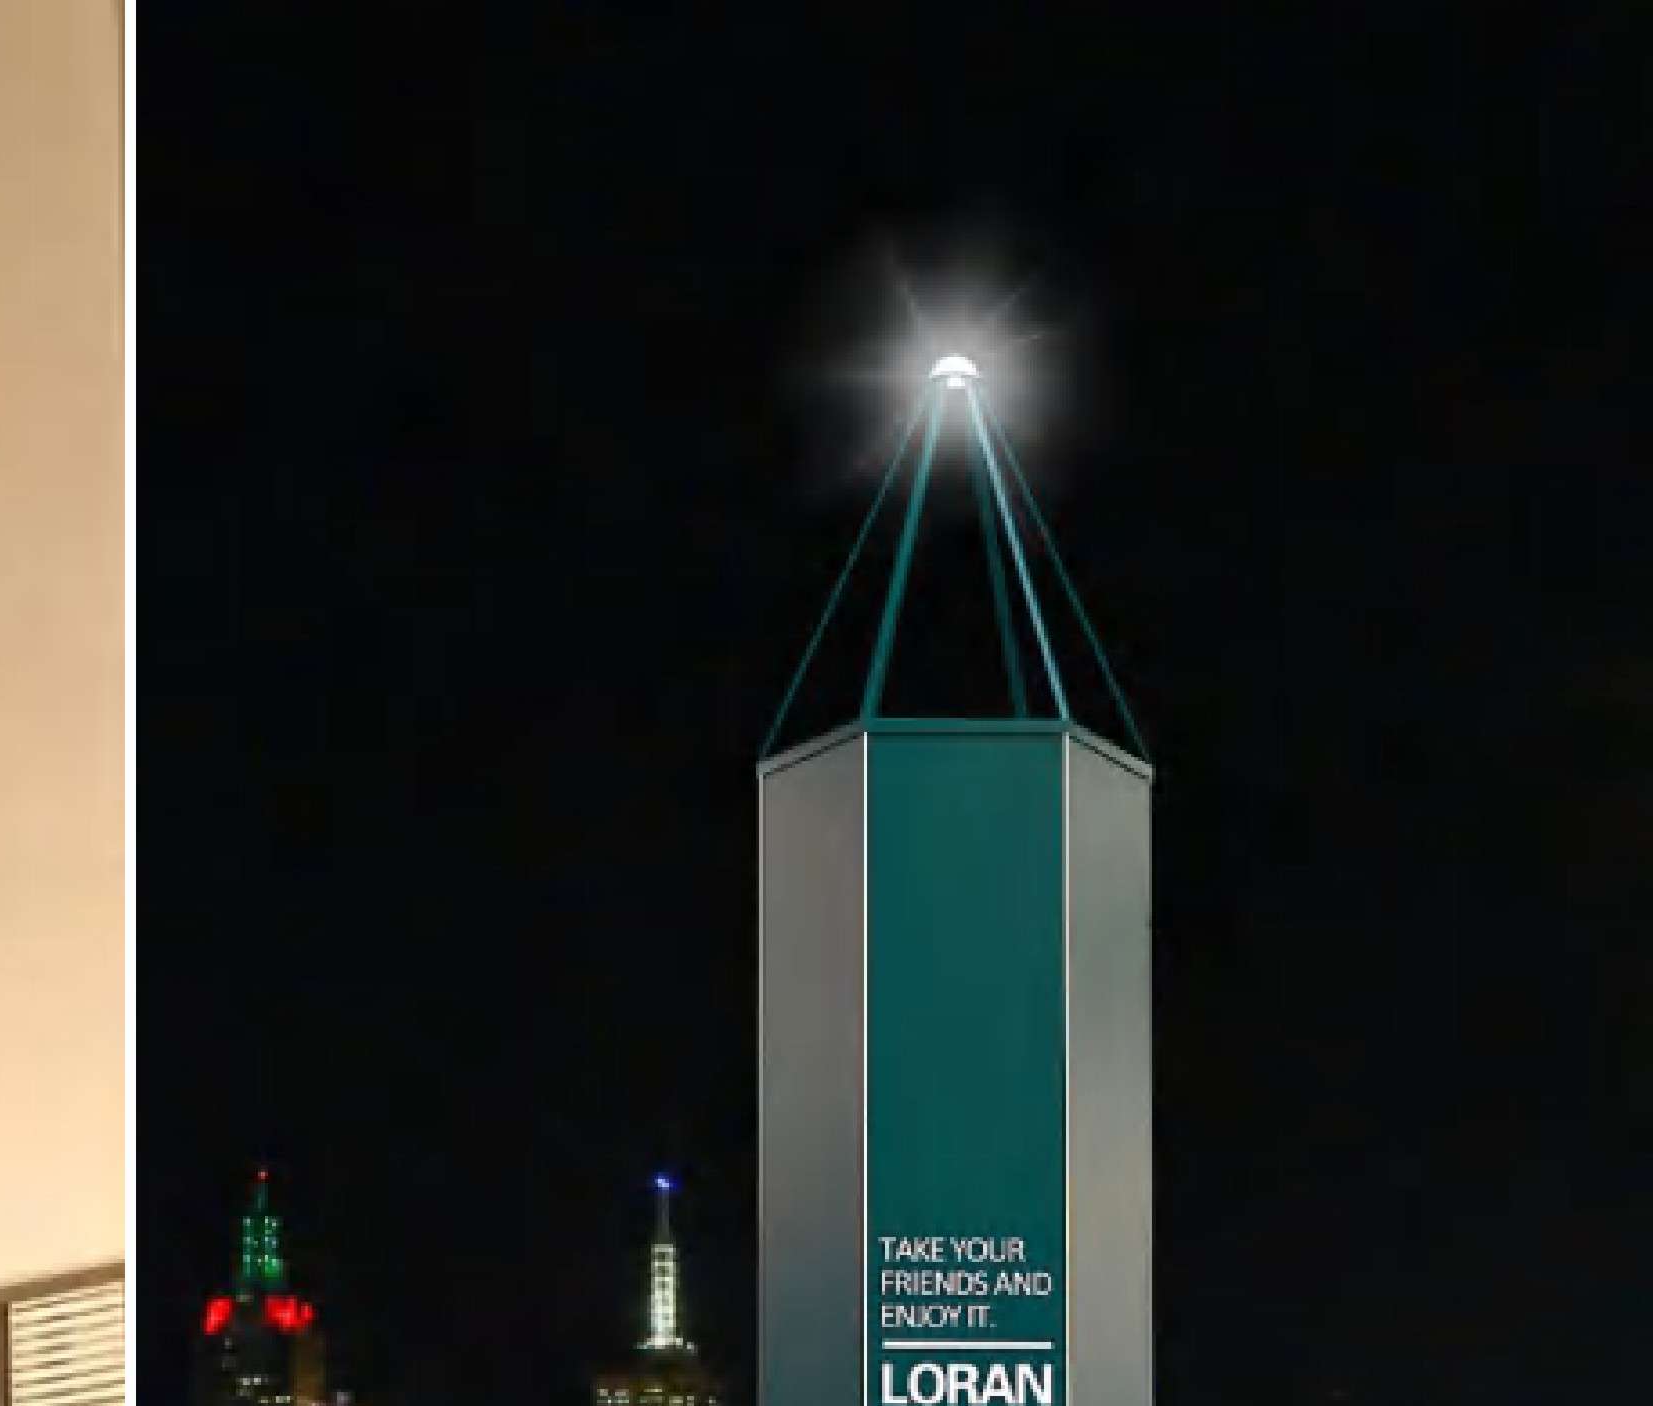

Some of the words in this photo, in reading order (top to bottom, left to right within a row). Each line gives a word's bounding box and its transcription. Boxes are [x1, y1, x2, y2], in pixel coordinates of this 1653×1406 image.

[879, 1236, 944, 1263] TAKE
[950, 1236, 1027, 1263] YOUR
[880, 1271, 989, 1296] FRIENDS
[993, 1271, 1053, 1296] AND
[880, 1304, 962, 1328] ENJOY
[966, 1304, 998, 1328] IT.
